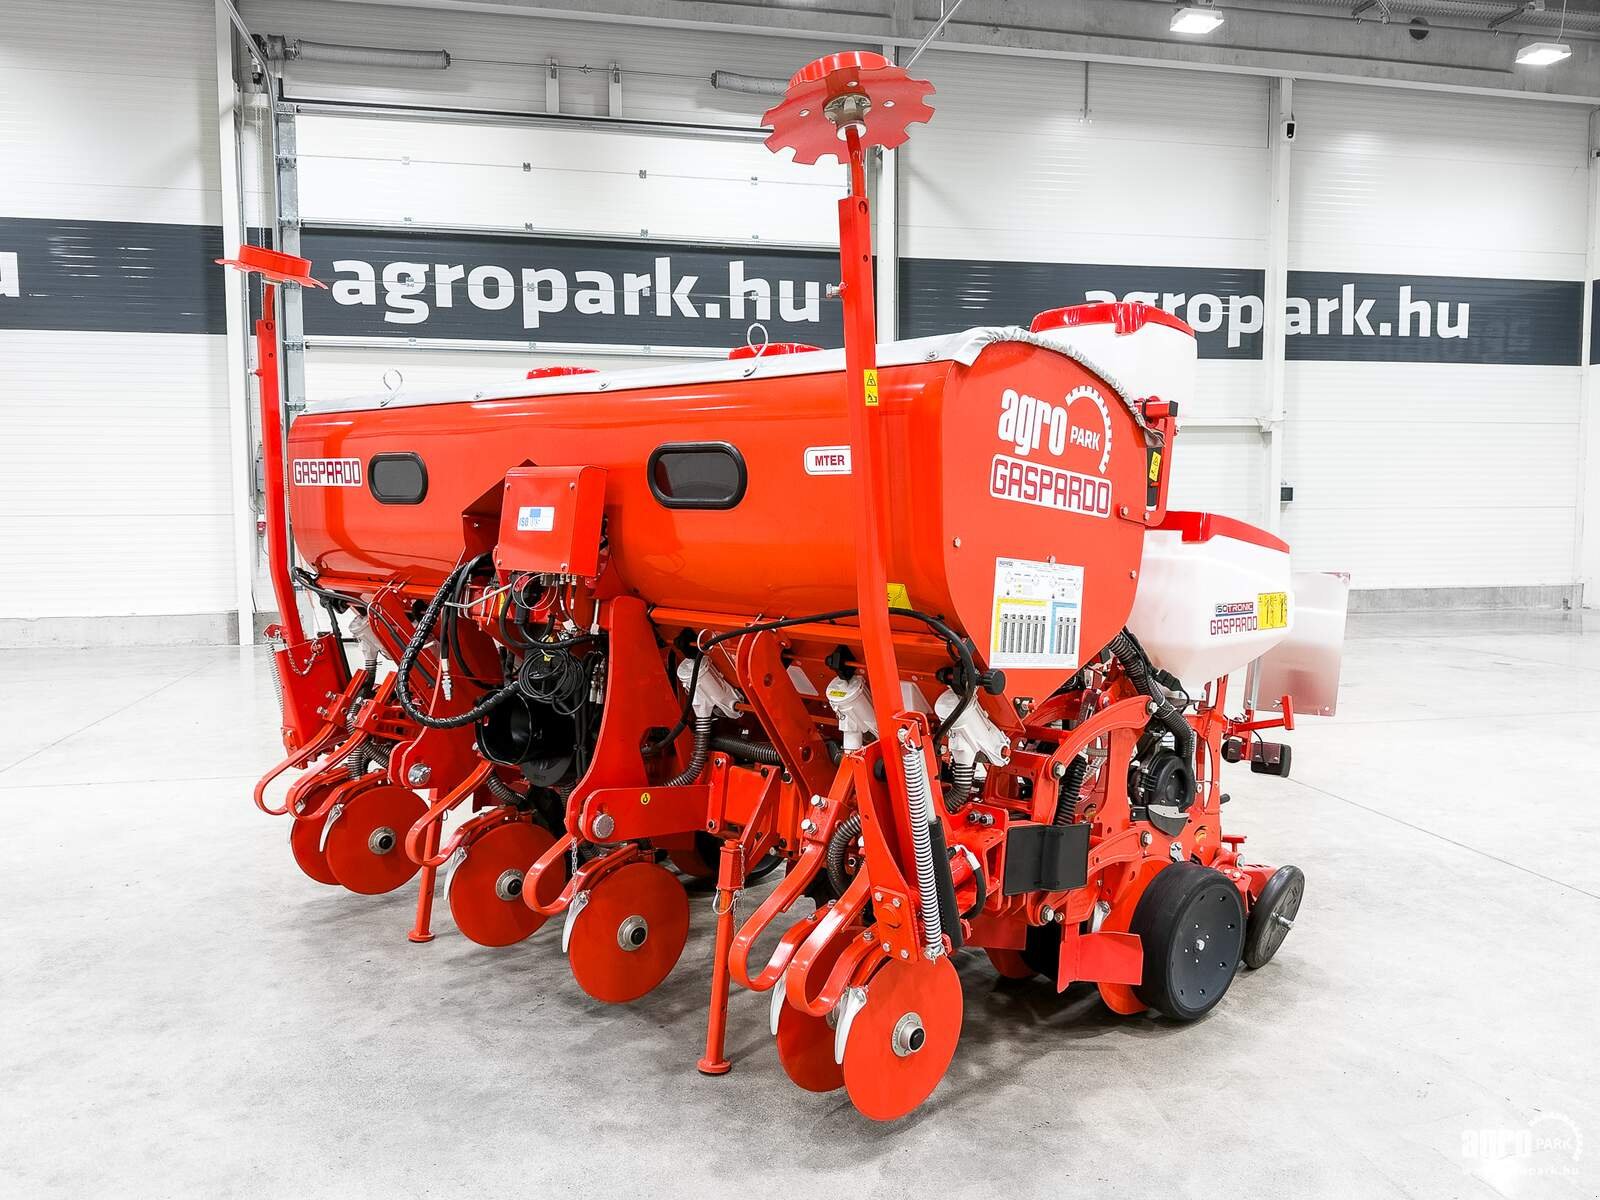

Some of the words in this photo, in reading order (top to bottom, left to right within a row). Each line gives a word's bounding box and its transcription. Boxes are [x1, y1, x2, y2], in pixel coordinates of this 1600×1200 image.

[332, 256, 820, 329] agropark.hu
[997, 388, 1068, 456] agro
[1069, 425, 1101, 451] PARK
[294, 461, 361, 484] GASPARDO
[815, 455, 845, 466] MTER
[992, 458, 1110, 515] GASPARDO
[1210, 615, 1258, 635] GASPARDO
